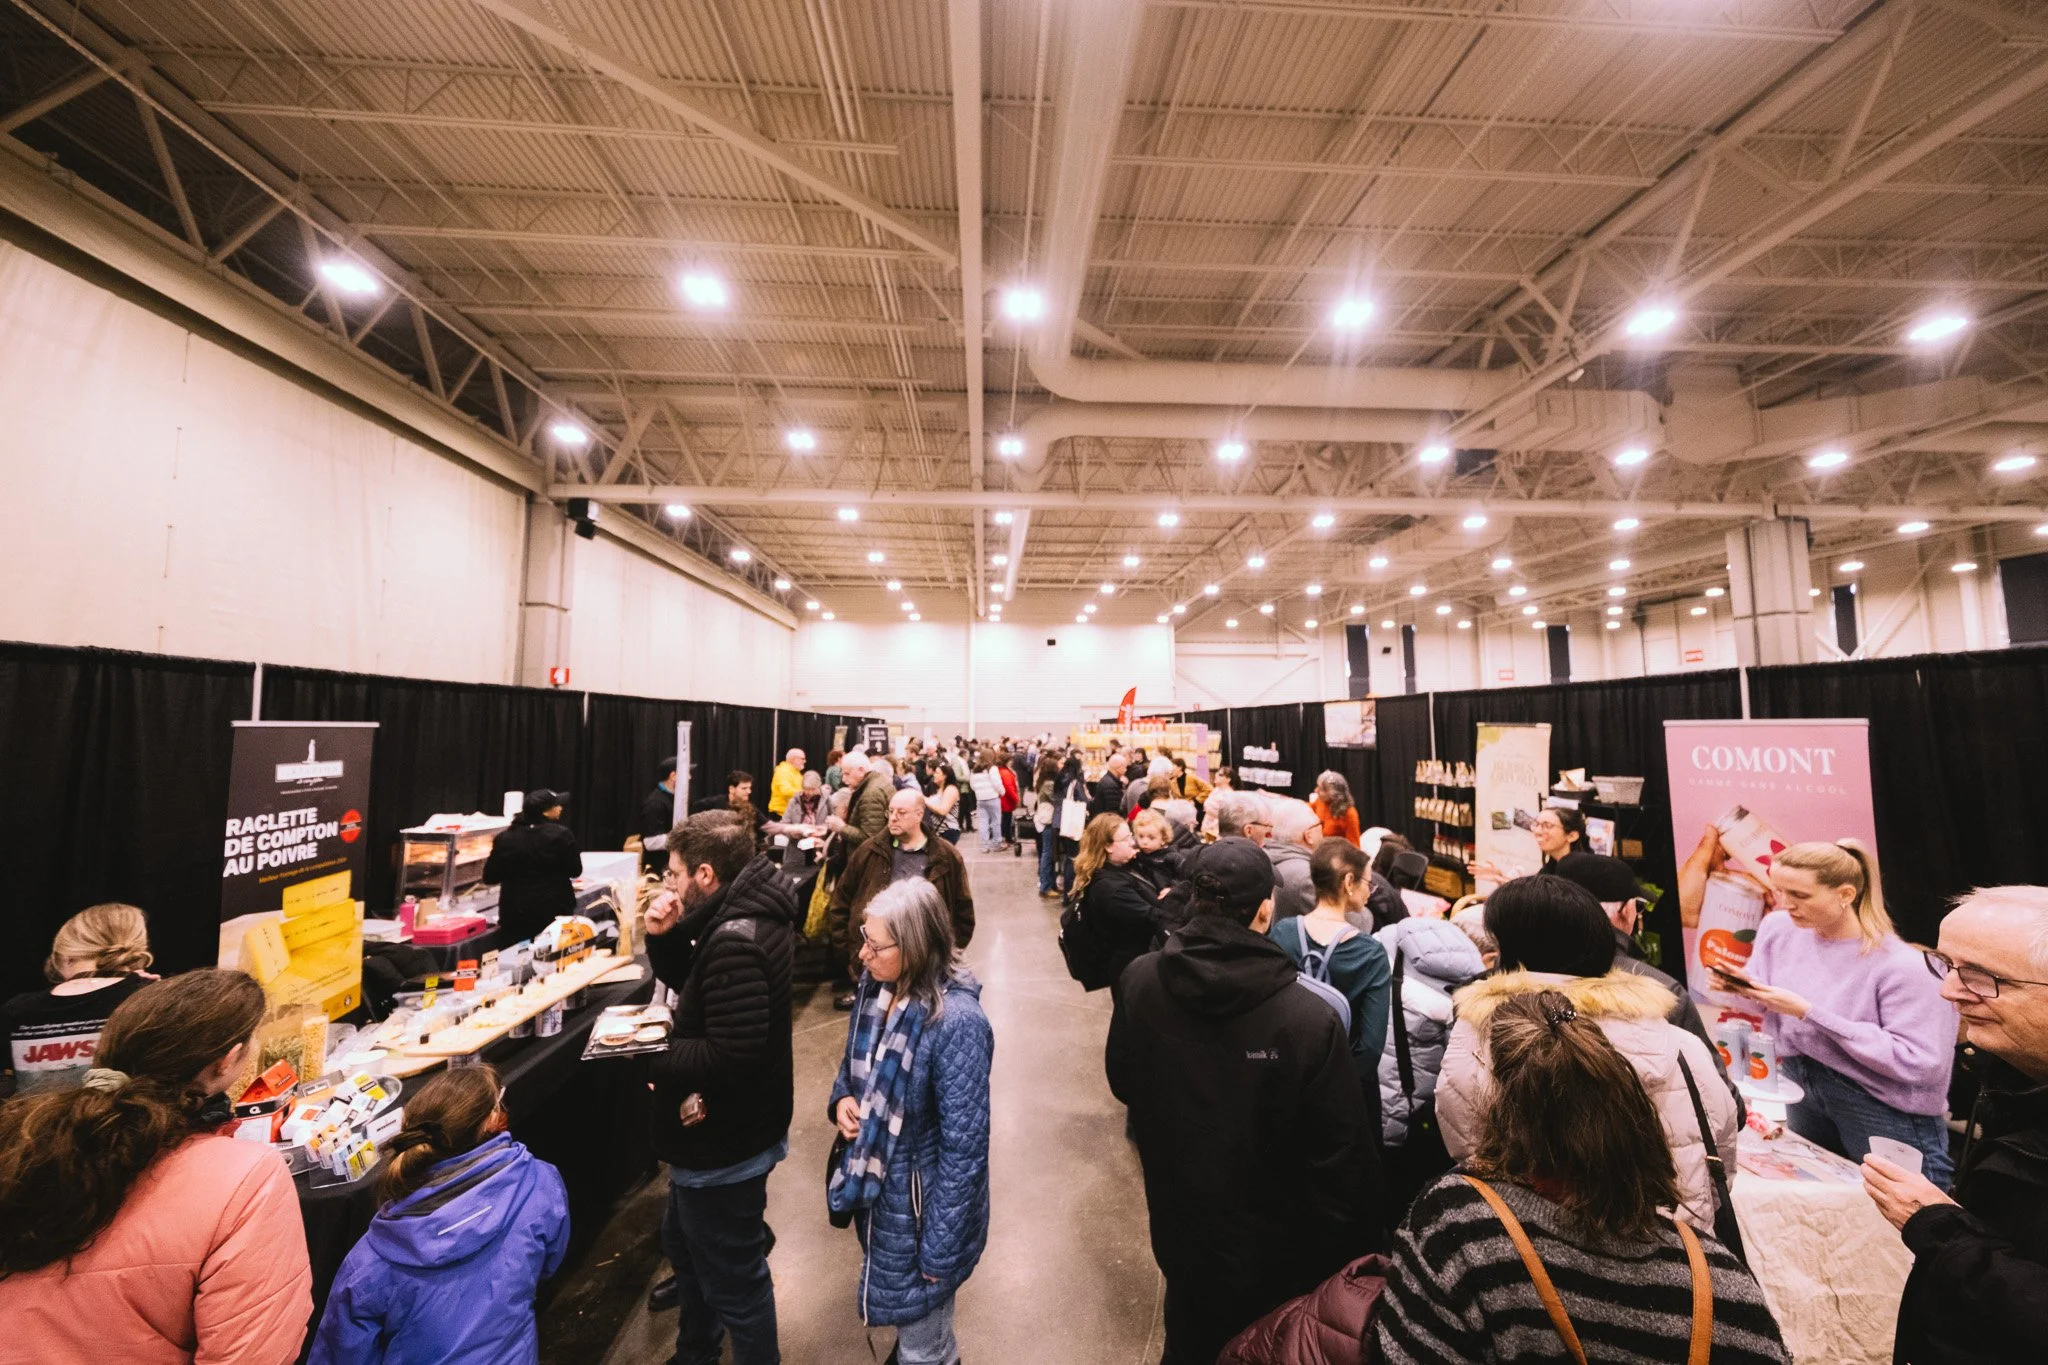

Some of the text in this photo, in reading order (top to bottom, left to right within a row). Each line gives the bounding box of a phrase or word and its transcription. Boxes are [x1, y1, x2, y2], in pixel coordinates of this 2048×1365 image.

[1691, 745, 1836, 775] COMONT
[1740, 780, 1776, 791] SANS
[1785, 784, 1847, 795] ALCOOL
[225, 807, 318, 837] RACLETTE
[224, 821, 339, 857] DE COMPTON
[223, 842, 318, 878] AU POIVRE
[1706, 938, 1747, 963] Palom
[23, 1040, 95, 1063] JAWS
